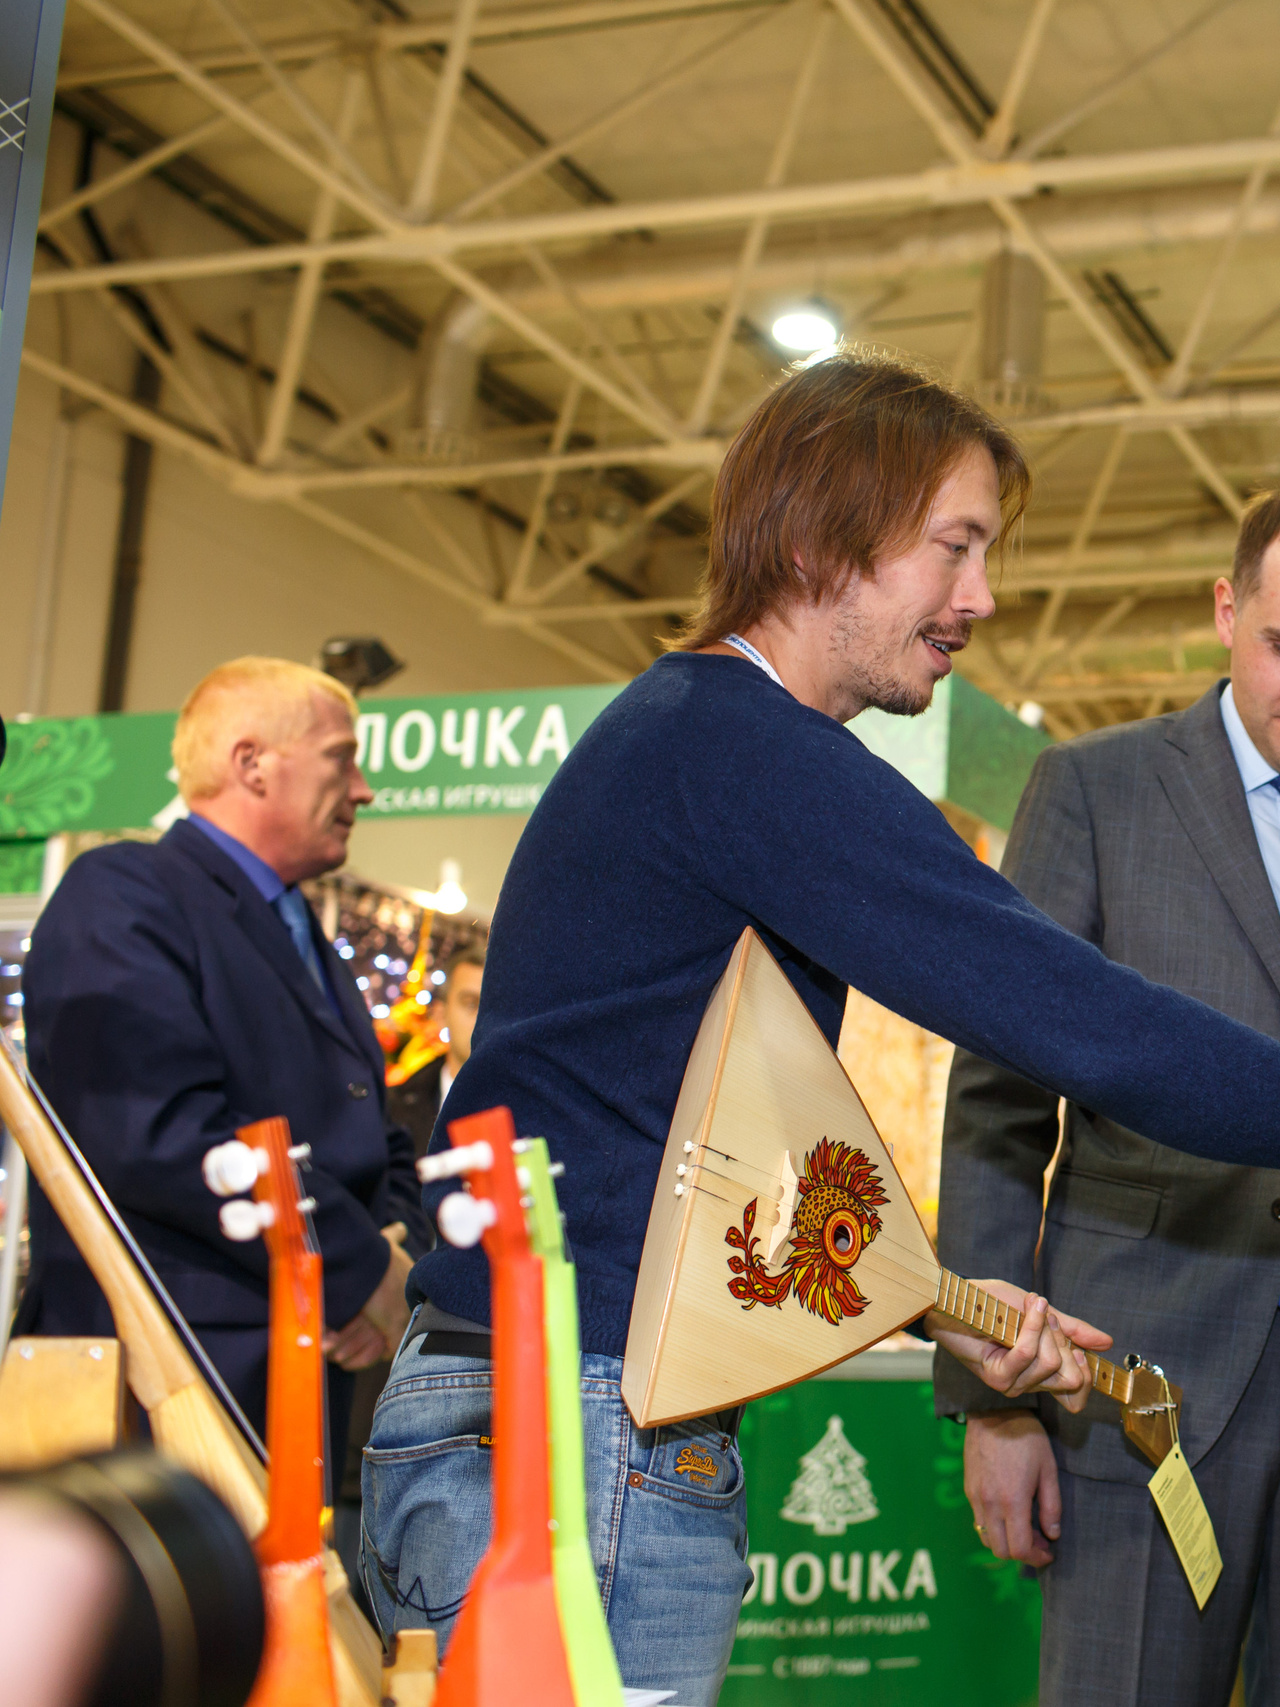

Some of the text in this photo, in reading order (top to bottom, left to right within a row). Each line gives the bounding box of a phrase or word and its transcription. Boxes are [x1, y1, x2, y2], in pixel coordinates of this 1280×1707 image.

[354, 704, 573, 773] ЛОЧКА
[373, 782, 541, 812] СКАЯ ИГРУШК
[742, 1549, 938, 1606] ЛОЧКА
[737, 1617, 831, 1640] ИНСКАЯ
